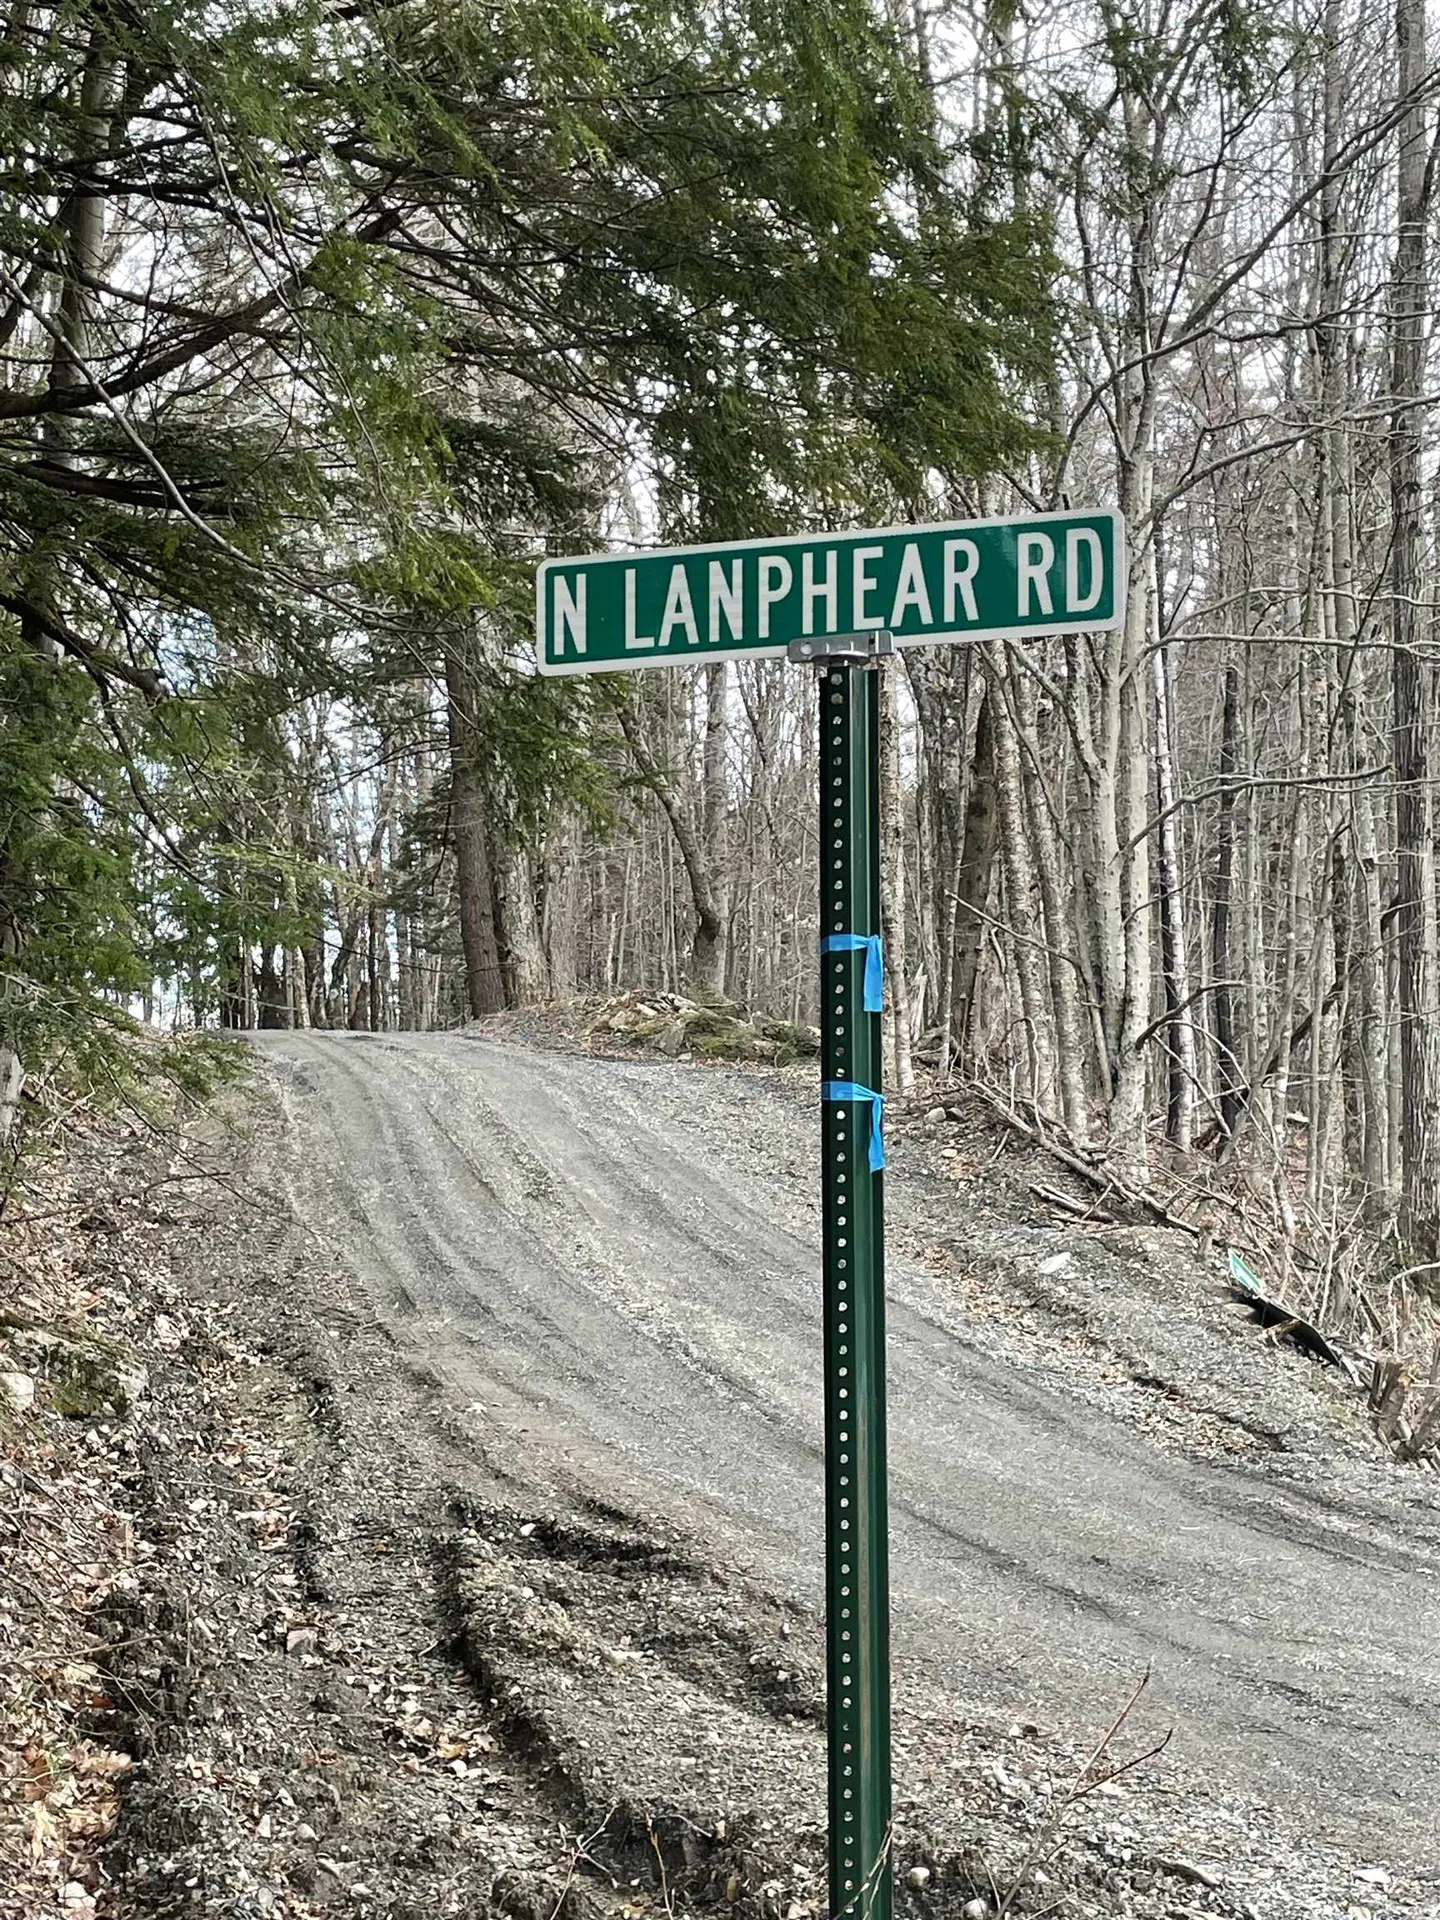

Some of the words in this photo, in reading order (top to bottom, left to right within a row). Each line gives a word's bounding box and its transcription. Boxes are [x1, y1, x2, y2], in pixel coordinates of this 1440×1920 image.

[553, 573, 588, 656] N
[625, 539, 981, 650] LANPHEAR
[1017, 527, 1104, 617] RD
